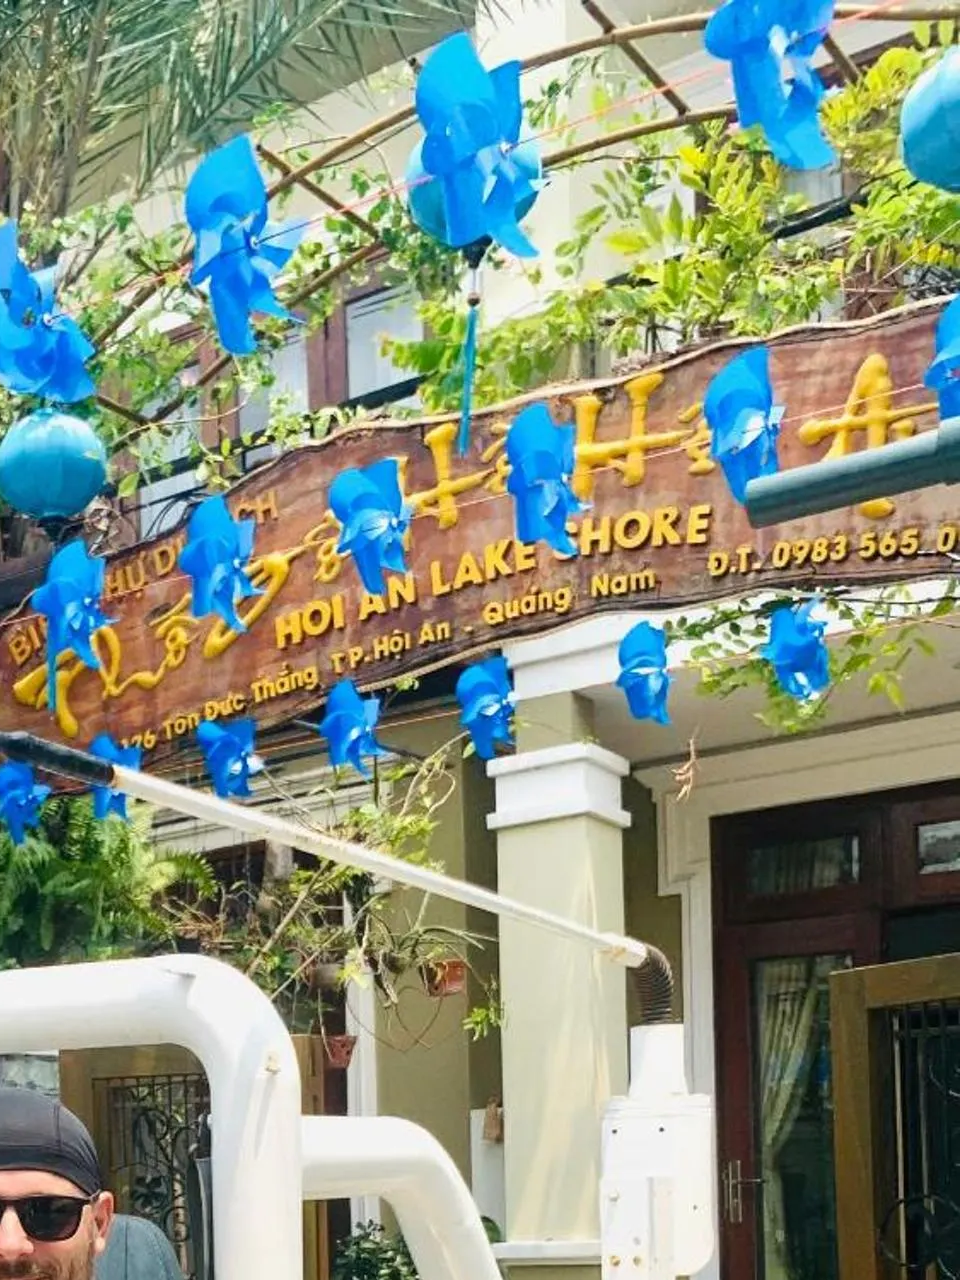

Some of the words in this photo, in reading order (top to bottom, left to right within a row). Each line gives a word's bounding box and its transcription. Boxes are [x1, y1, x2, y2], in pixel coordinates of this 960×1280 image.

[772, 534, 849, 569] 0983
[859, 527, 920, 559] 565
[275, 593, 345, 650] HOI
[358, 571, 417, 622] AN
[430, 539, 537, 596] LAKE
[591, 568, 656, 597] Nam
